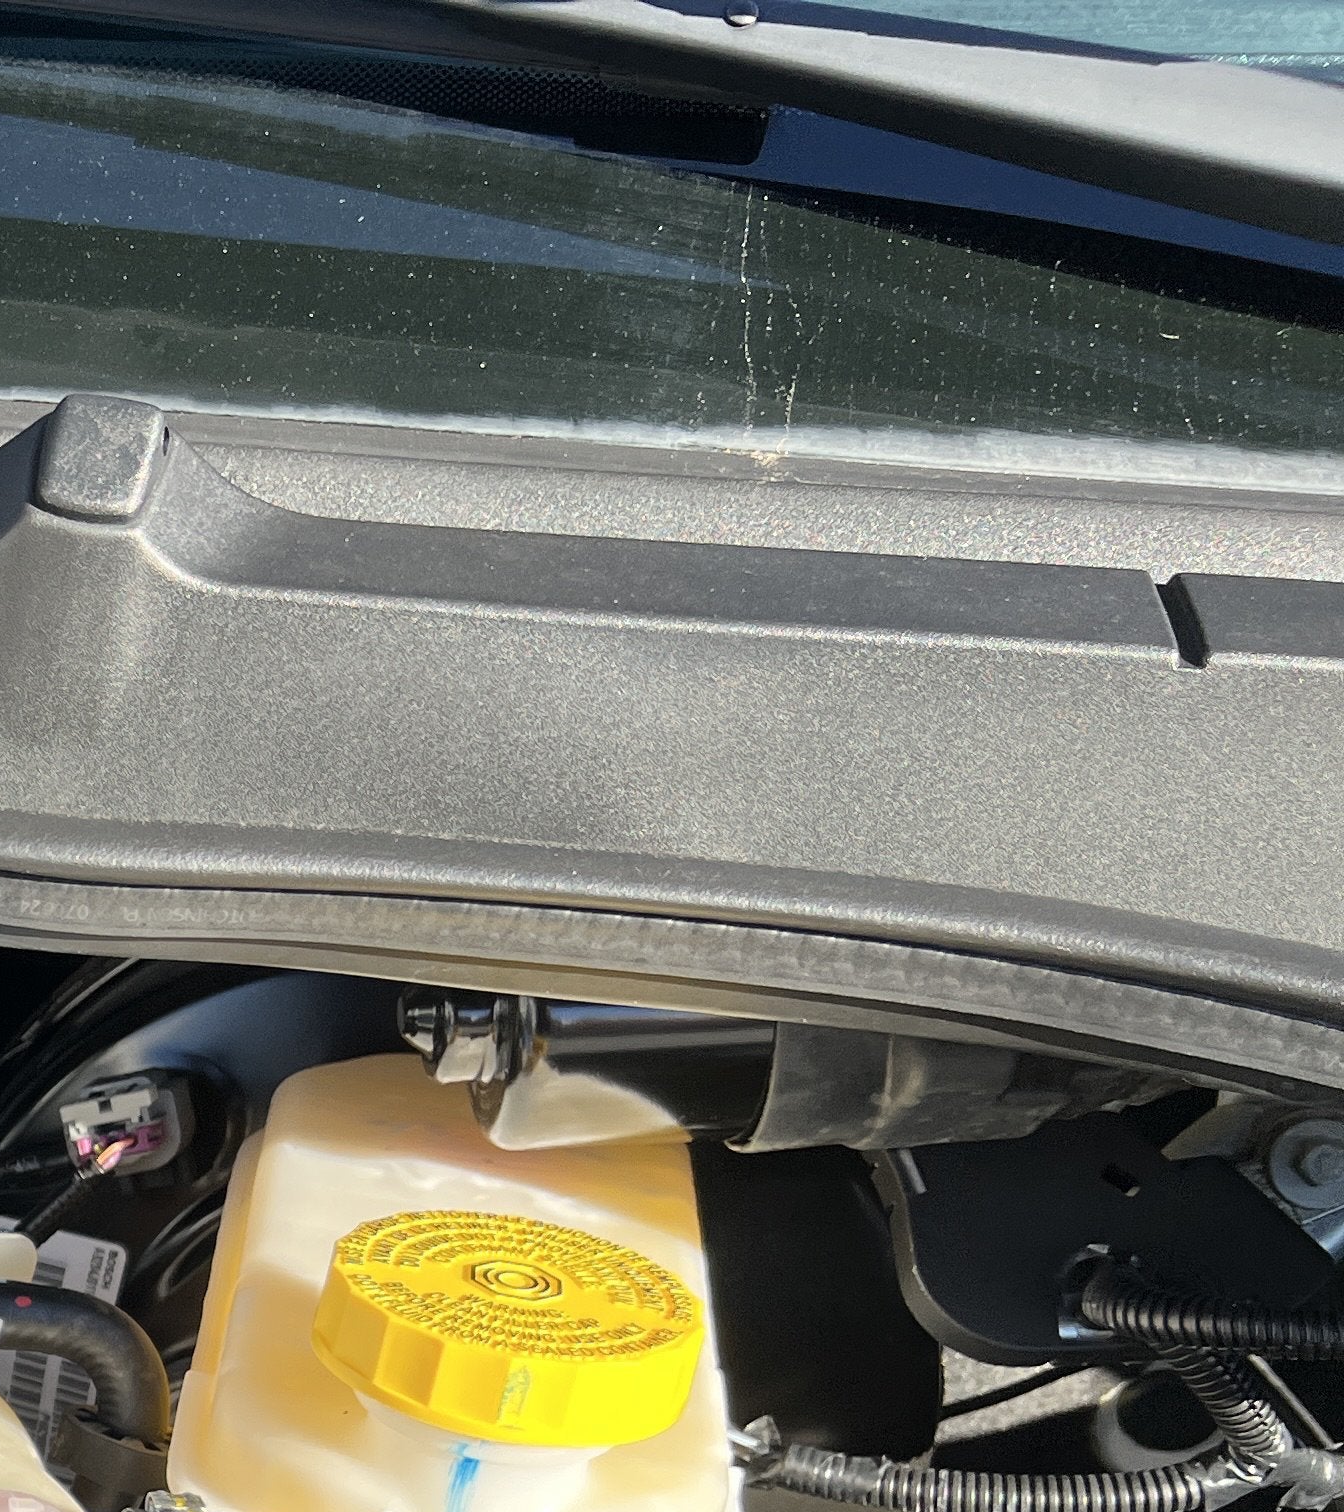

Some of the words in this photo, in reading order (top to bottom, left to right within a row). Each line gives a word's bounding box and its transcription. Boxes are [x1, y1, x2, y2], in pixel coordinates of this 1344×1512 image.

[380, 1281, 447, 1316] BEFORE
[420, 1291, 488, 1319] CLEAN
[428, 1321, 492, 1345] FROM
